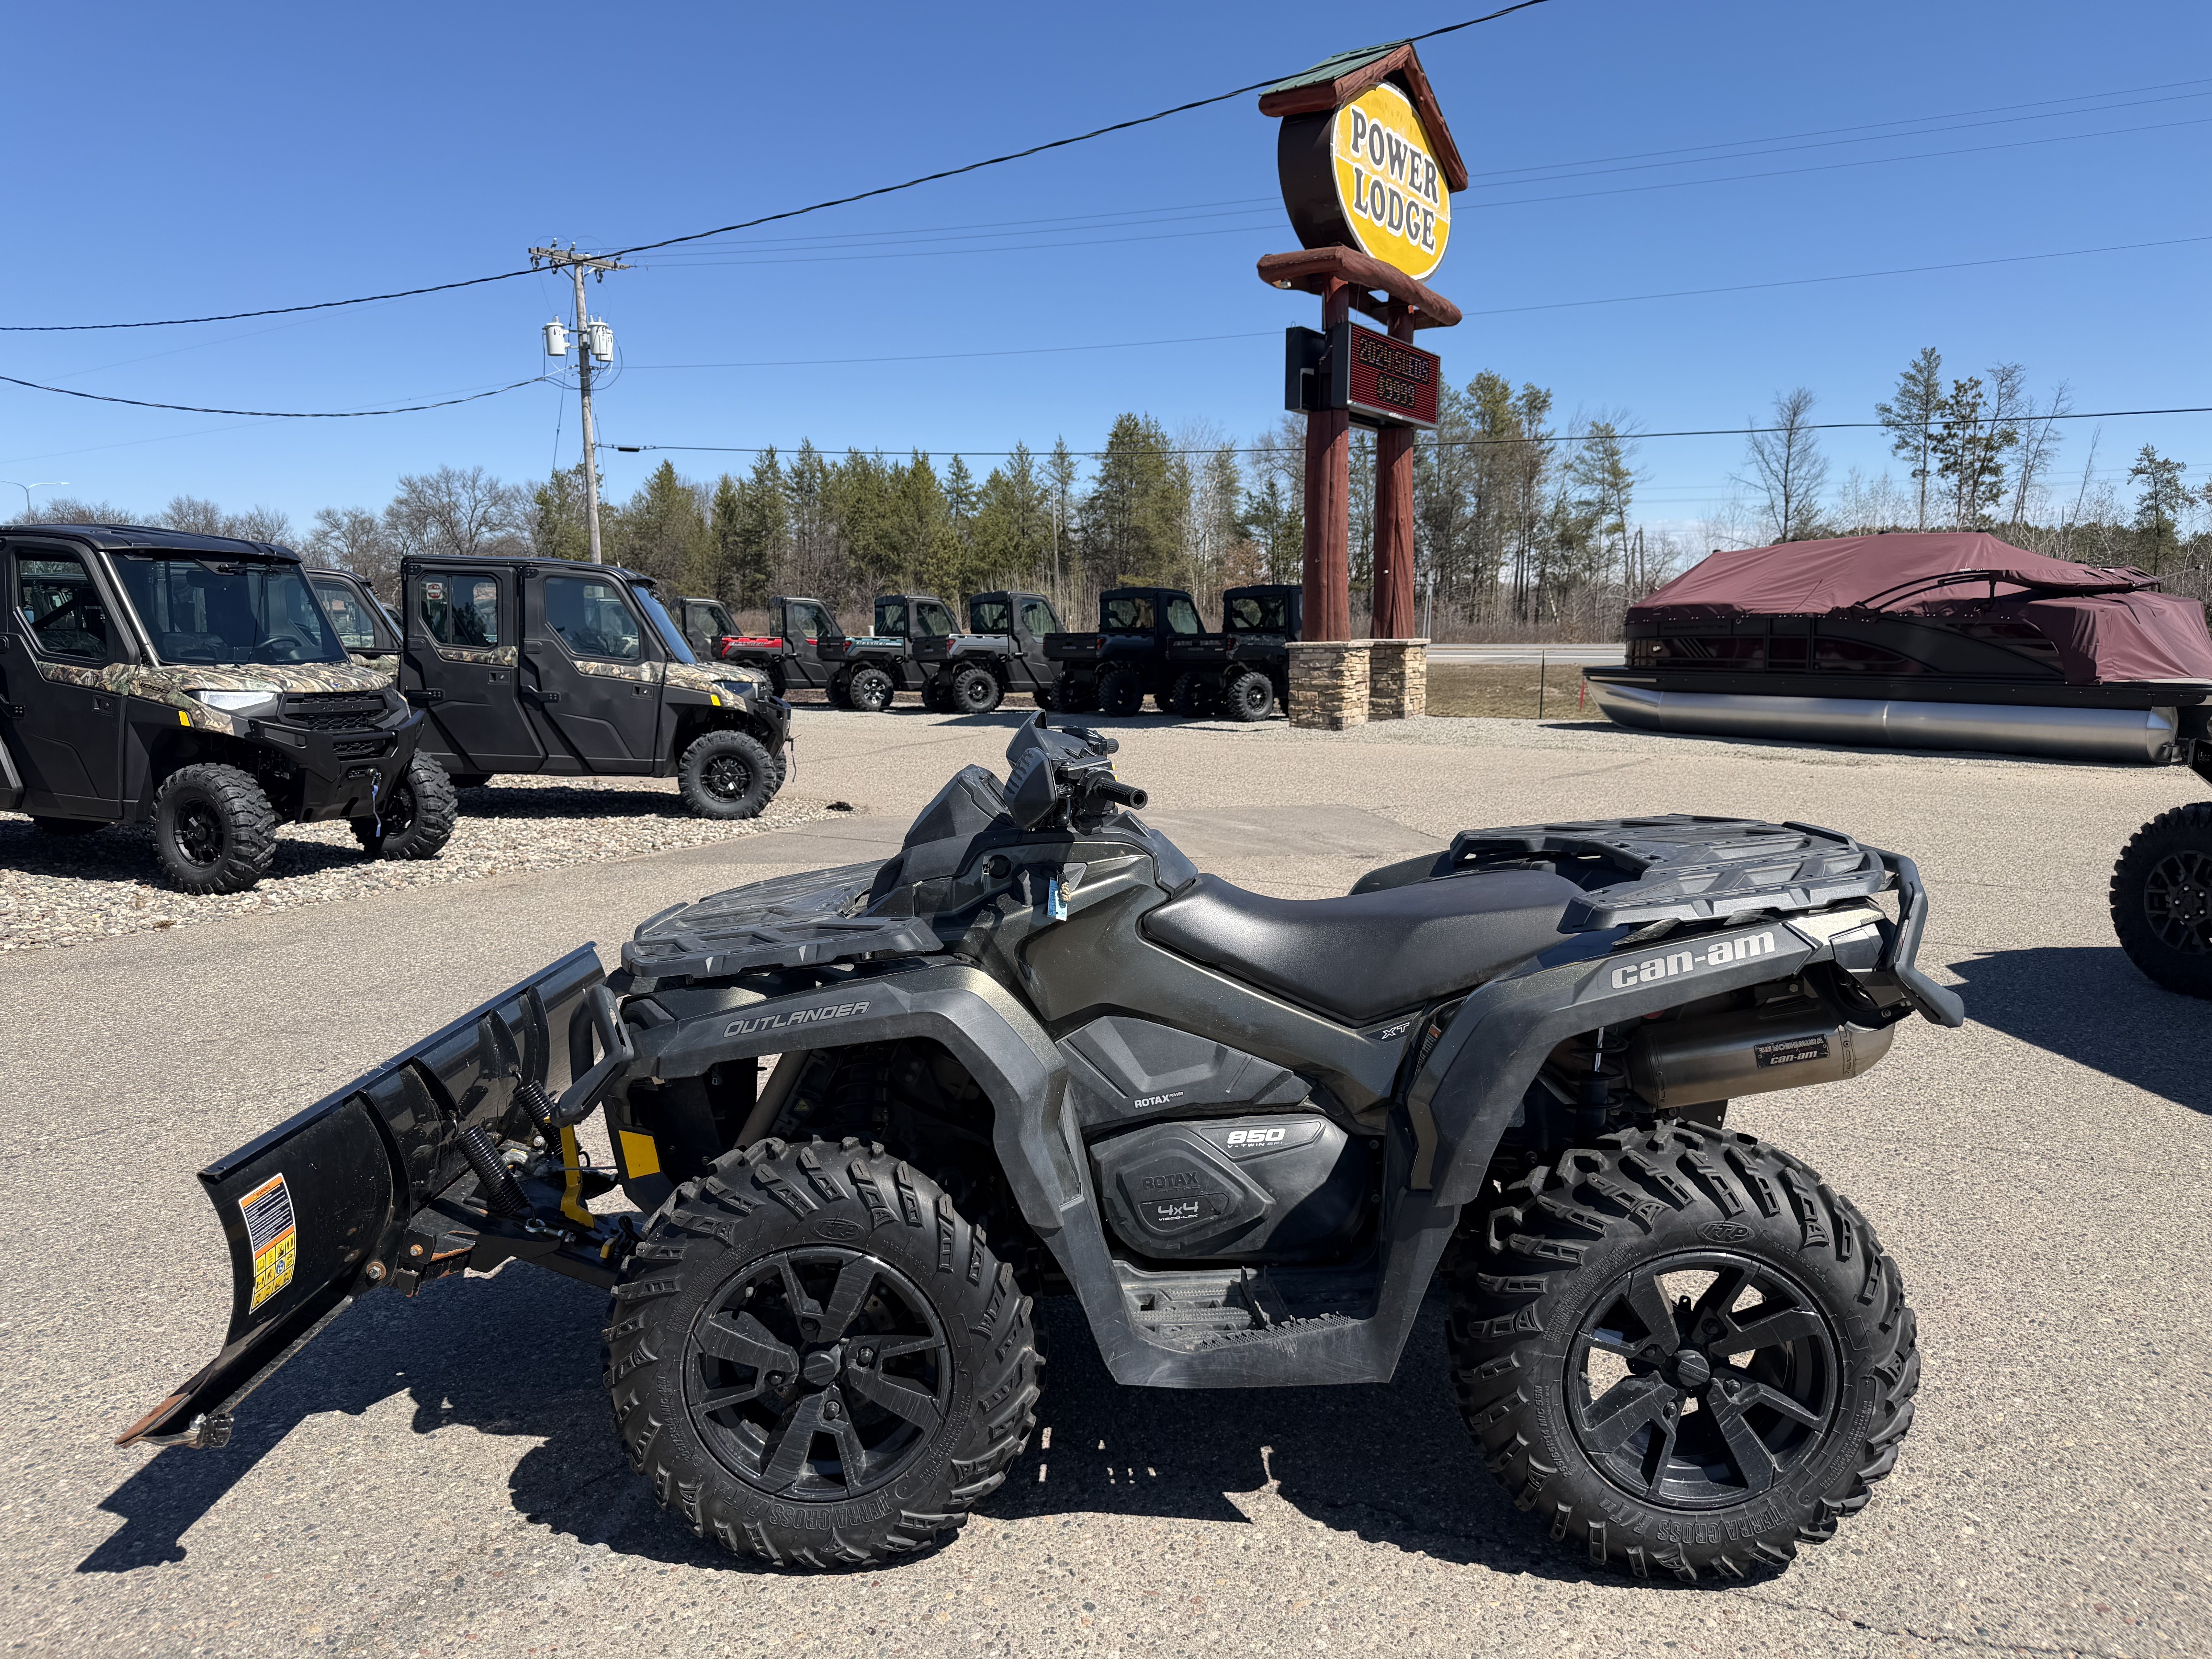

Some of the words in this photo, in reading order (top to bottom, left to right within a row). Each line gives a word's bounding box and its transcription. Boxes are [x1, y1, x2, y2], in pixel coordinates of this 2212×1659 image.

[1350, 107, 1438, 205] POWER
[1353, 166, 1435, 251] LODGE
[1359, 338, 1392, 369] 2024
[318, 703, 362, 713] POLARIS
[1611, 931, 1775, 989] can-am
[723, 1001, 870, 1037] OUTLANDER
[1381, 1022, 1410, 1040] XT
[1772, 1037, 1824, 1052] YOSHIMURA
[1770, 1051, 1818, 1065] can-am
[1134, 1094, 1170, 1108] ROTAX
[1227, 1128, 1286, 1144] 850
[256, 1184, 271, 1197] WARNING
[1142, 1171, 1199, 1190] ROTAX
[1158, 1201, 1199, 1216] 4x4
[1772, 1242, 1797, 1258] MADE
[1534, 1385, 1543, 1407] 55M
[1536, 1407, 1548, 1427] M/C
[769, 1503, 830, 1530] CROSS
[834, 1495, 894, 1528] TERRA
[1608, 1504, 1654, 1535] R/T
[1657, 1520, 1720, 1544] CROSS
[1724, 1505, 1786, 1541] TERRA
